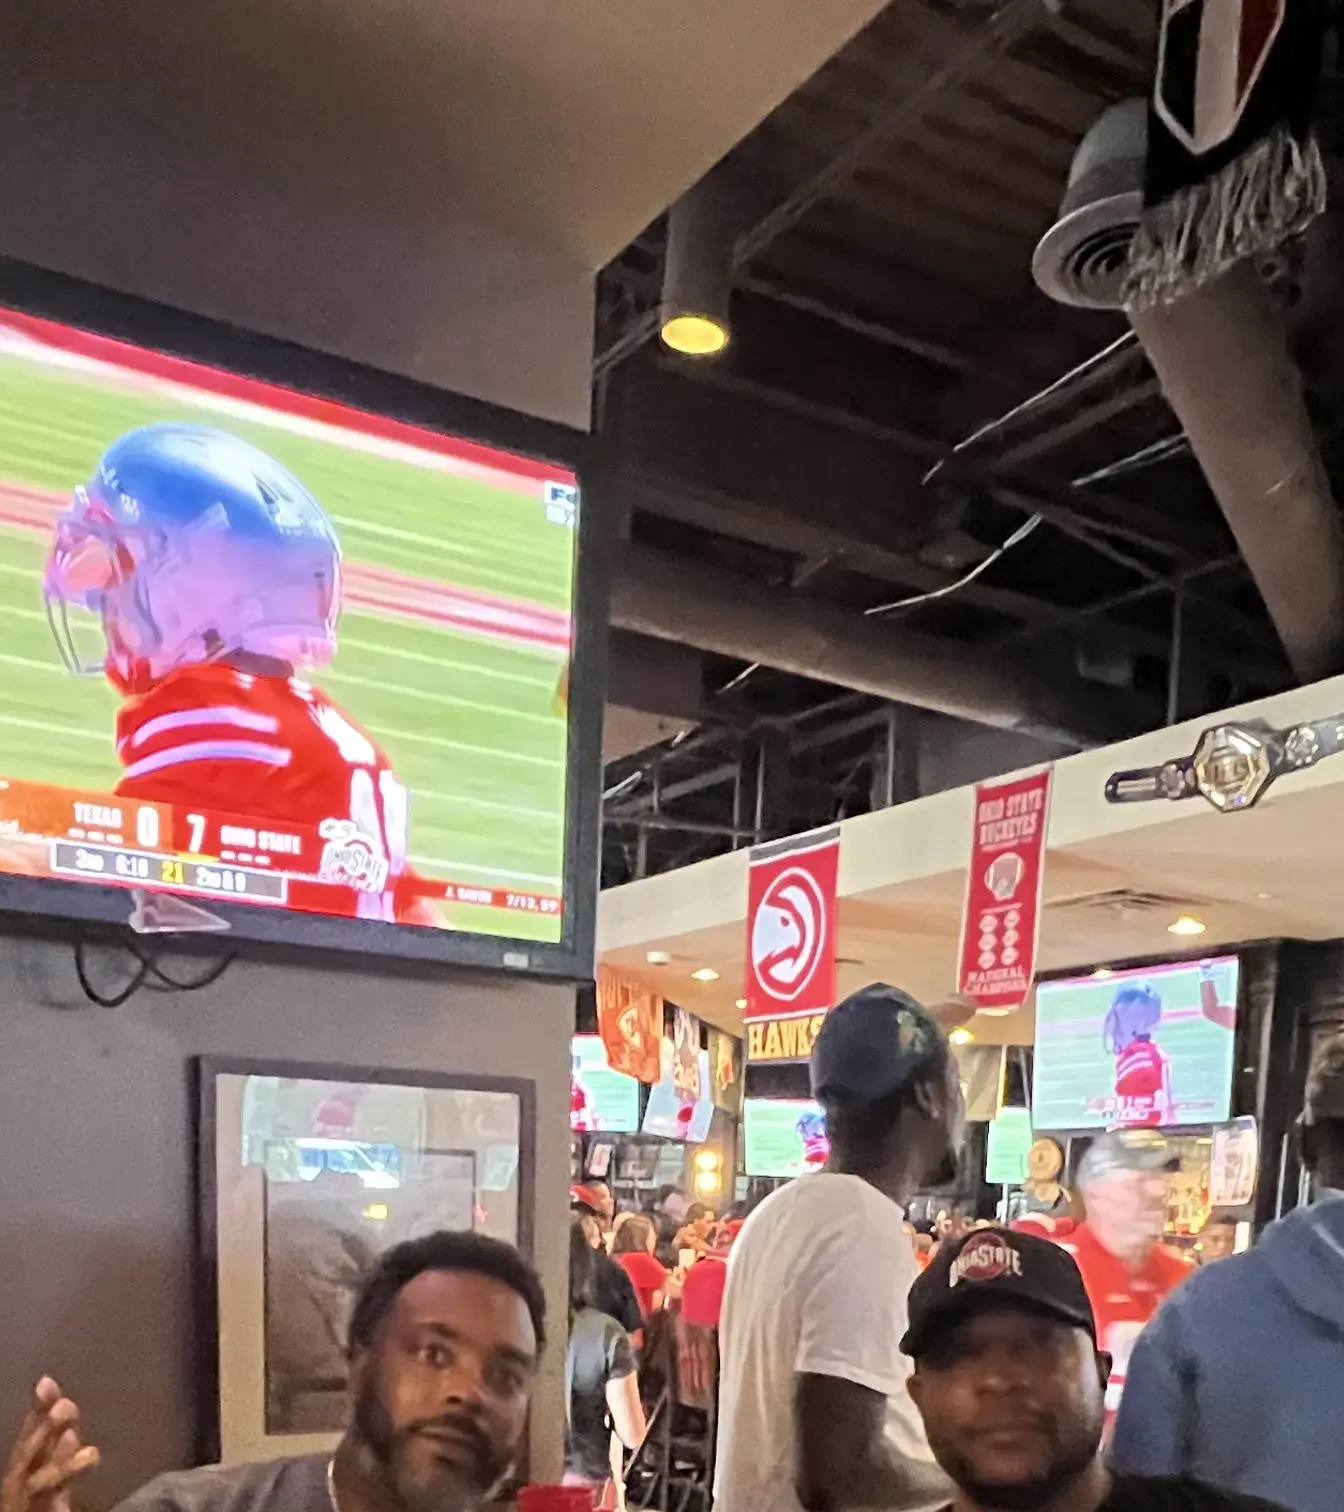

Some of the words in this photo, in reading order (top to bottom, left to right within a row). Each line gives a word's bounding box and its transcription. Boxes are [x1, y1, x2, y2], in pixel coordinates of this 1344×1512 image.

[136, 805, 159, 847] 0
[186, 813, 206, 853] 7
[161, 860, 185, 885] 21
